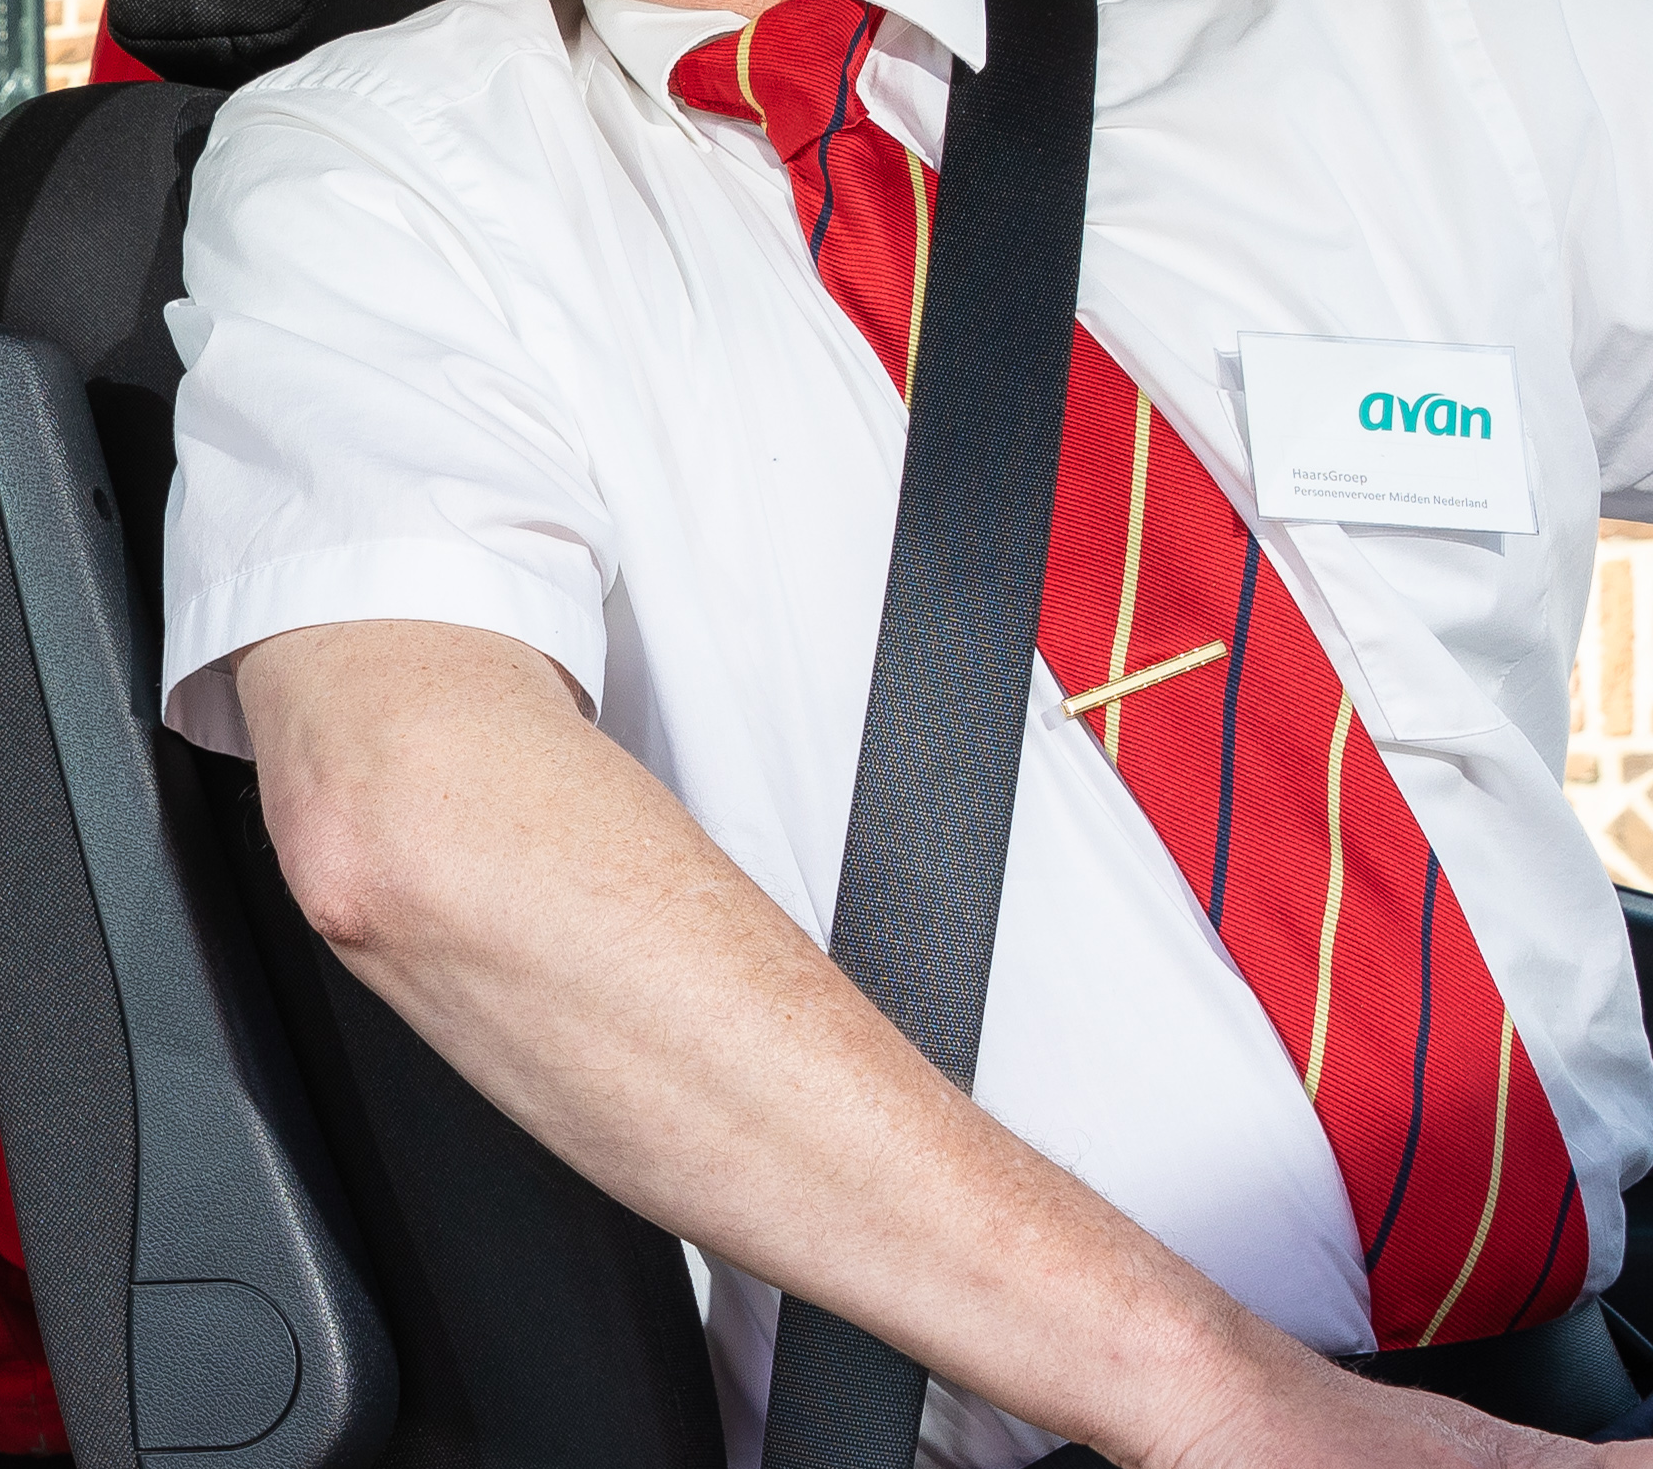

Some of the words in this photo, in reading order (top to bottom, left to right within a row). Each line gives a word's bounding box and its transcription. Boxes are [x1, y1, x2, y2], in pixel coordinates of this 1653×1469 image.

[1359, 392, 1492, 440] avan
[1292, 468, 1368, 485] HaarsGroep
[1294, 486, 1386, 502] Personenvervoer
[1389, 492, 1431, 505] Midden
[1433, 495, 1488, 509] Nederland
